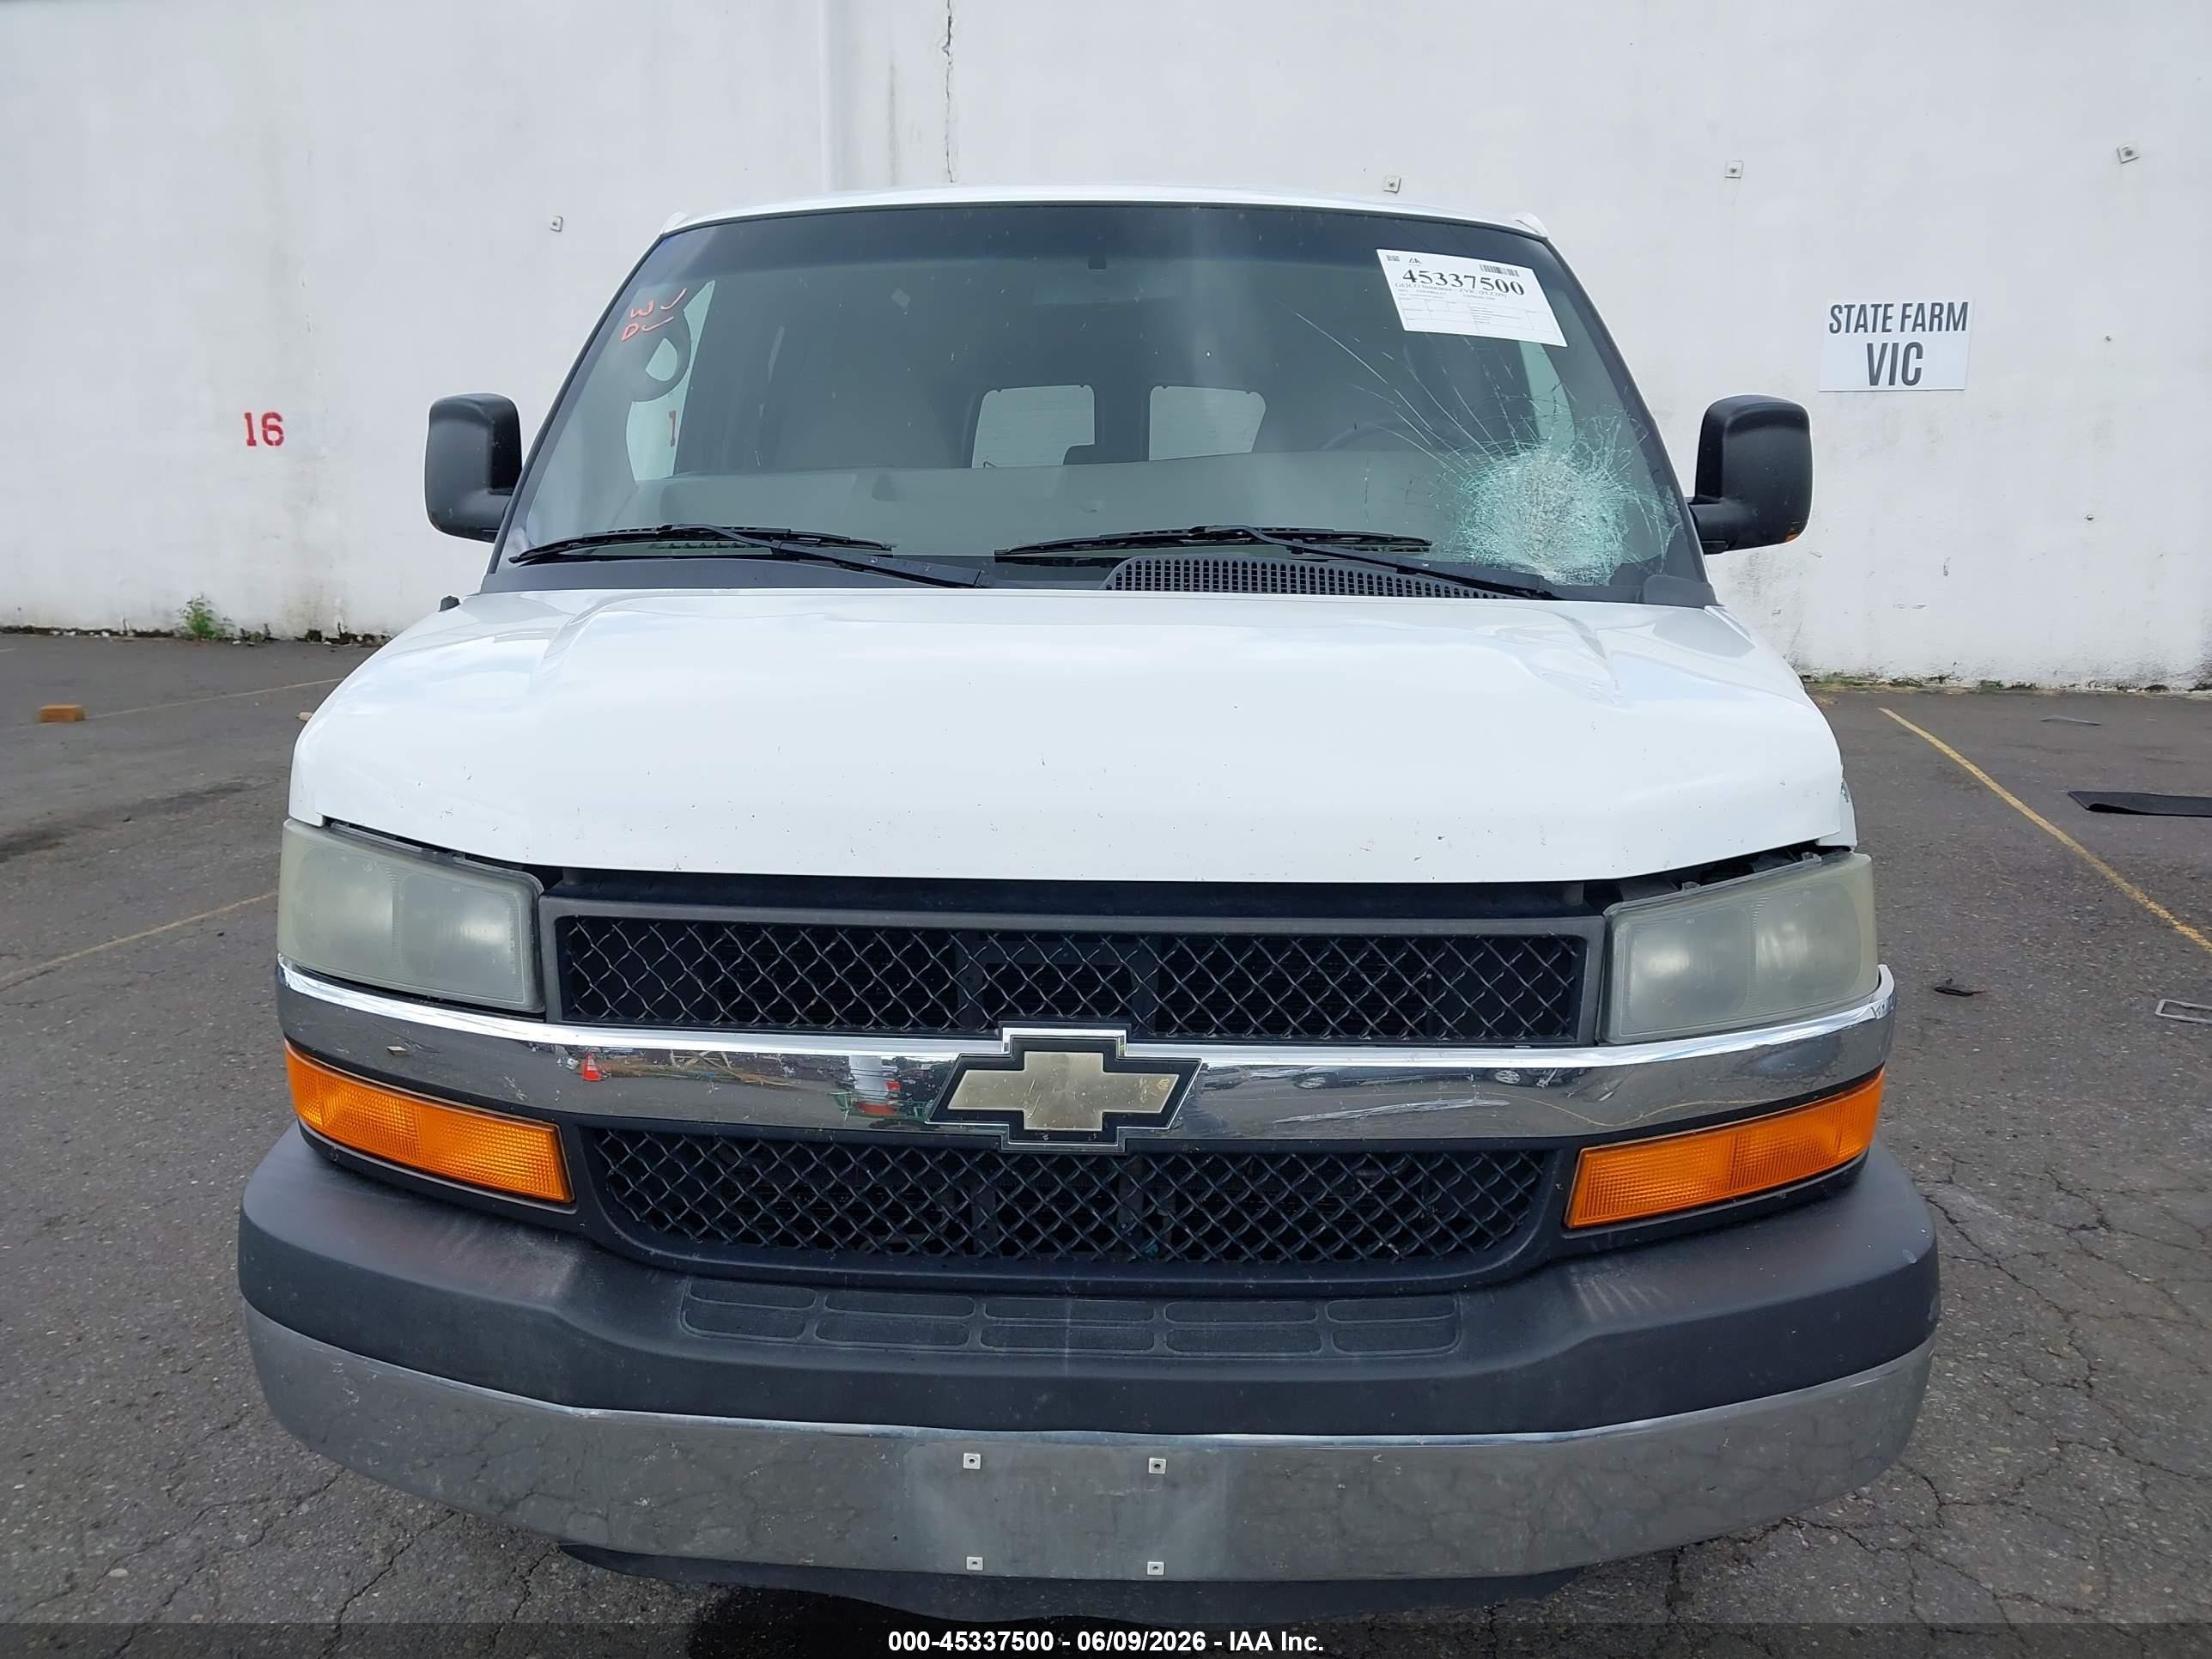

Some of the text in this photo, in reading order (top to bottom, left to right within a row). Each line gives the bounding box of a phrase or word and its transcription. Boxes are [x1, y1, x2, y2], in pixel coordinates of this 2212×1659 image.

[1402, 269, 1525, 295] 45337500
[1828, 301, 1968, 334] STATE FARM
[1867, 341, 1923, 386] VIC
[244, 412, 284, 447] 16
